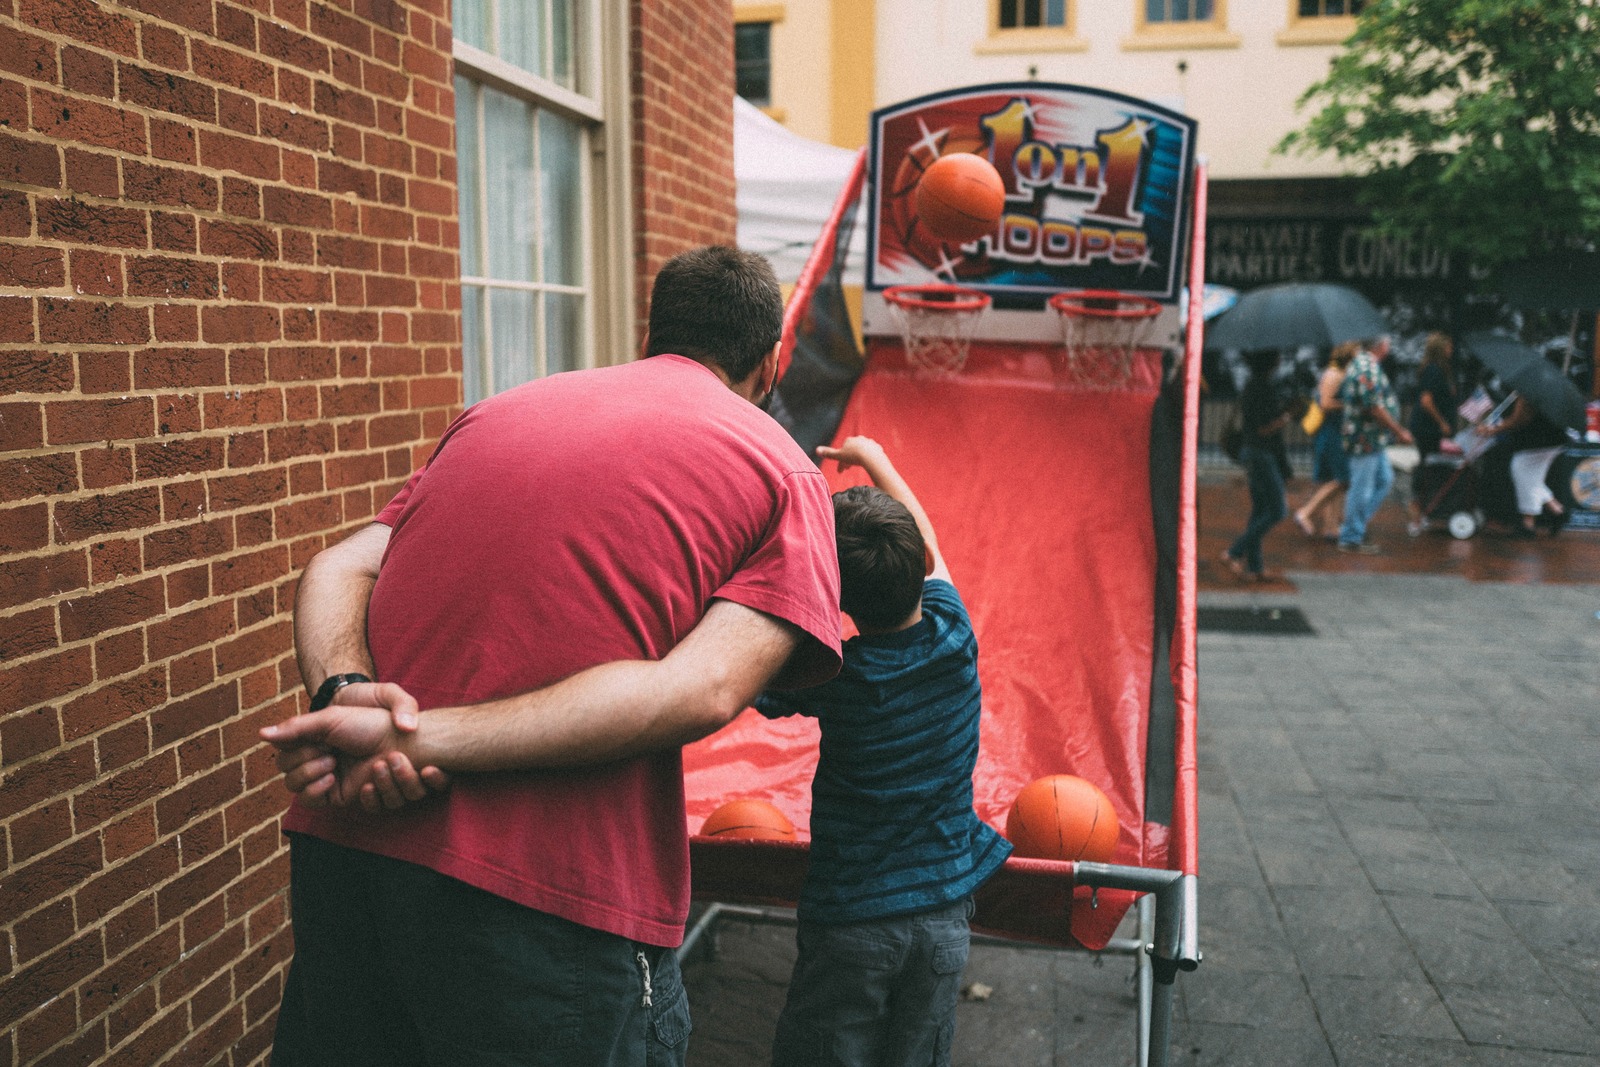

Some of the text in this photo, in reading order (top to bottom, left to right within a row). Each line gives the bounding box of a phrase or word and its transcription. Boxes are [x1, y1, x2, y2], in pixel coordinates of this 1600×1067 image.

[981, 98, 1146, 227] 1 on 1
[1211, 224, 1322, 249] PRIVATE
[1211, 254, 1323, 279] PARTIES
